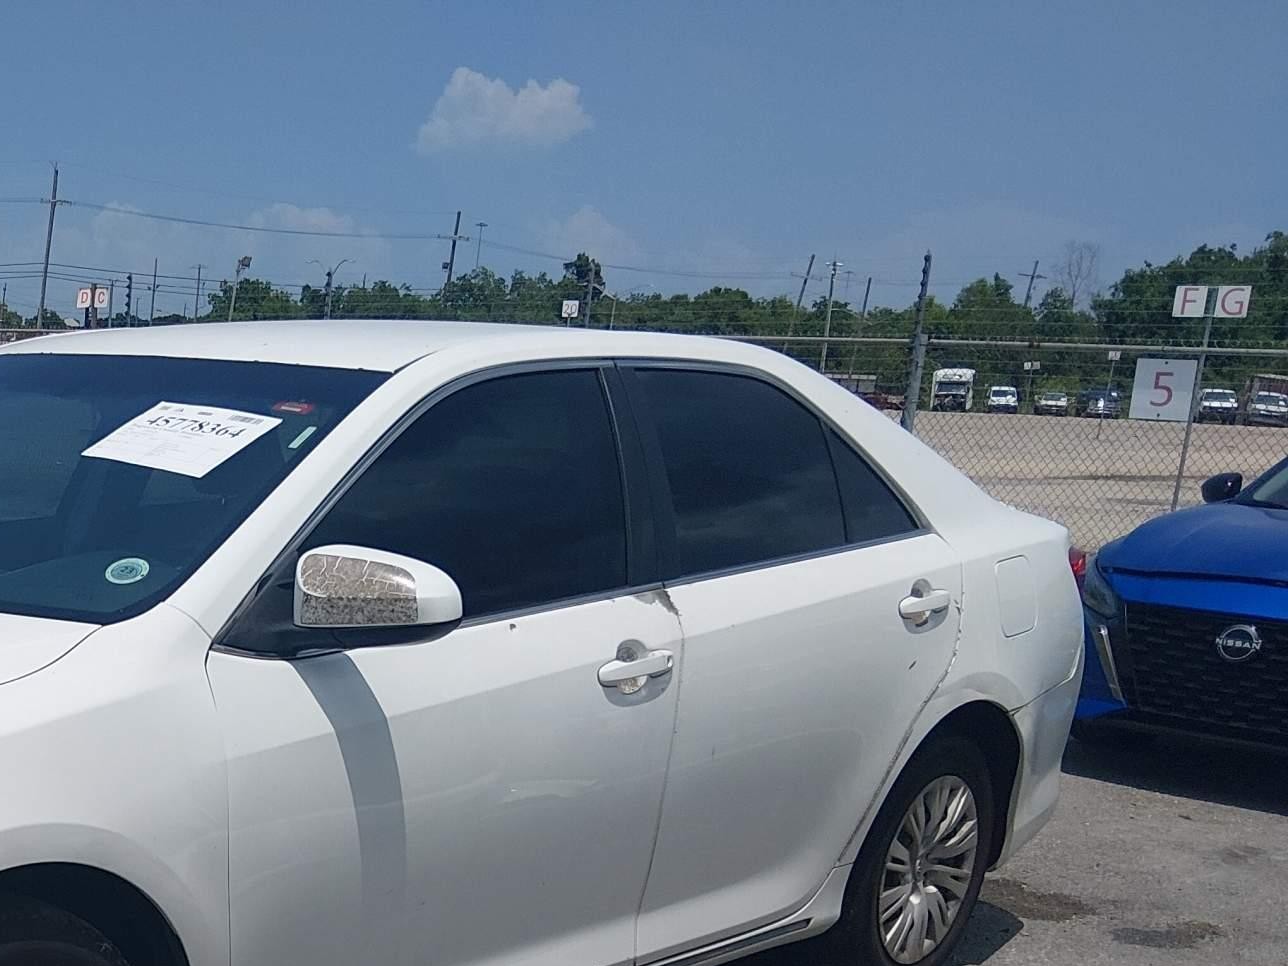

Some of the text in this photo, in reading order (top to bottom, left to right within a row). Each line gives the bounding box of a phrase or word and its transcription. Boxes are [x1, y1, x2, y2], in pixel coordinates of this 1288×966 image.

[81, 291, 106, 304] D C
[1180, 287, 1246, 316] F G
[563, 303, 577, 314] 20
[1149, 371, 1175, 407] 5
[146, 415, 248, 439] 45778364
[1215, 637, 1262, 651] NISSAN
